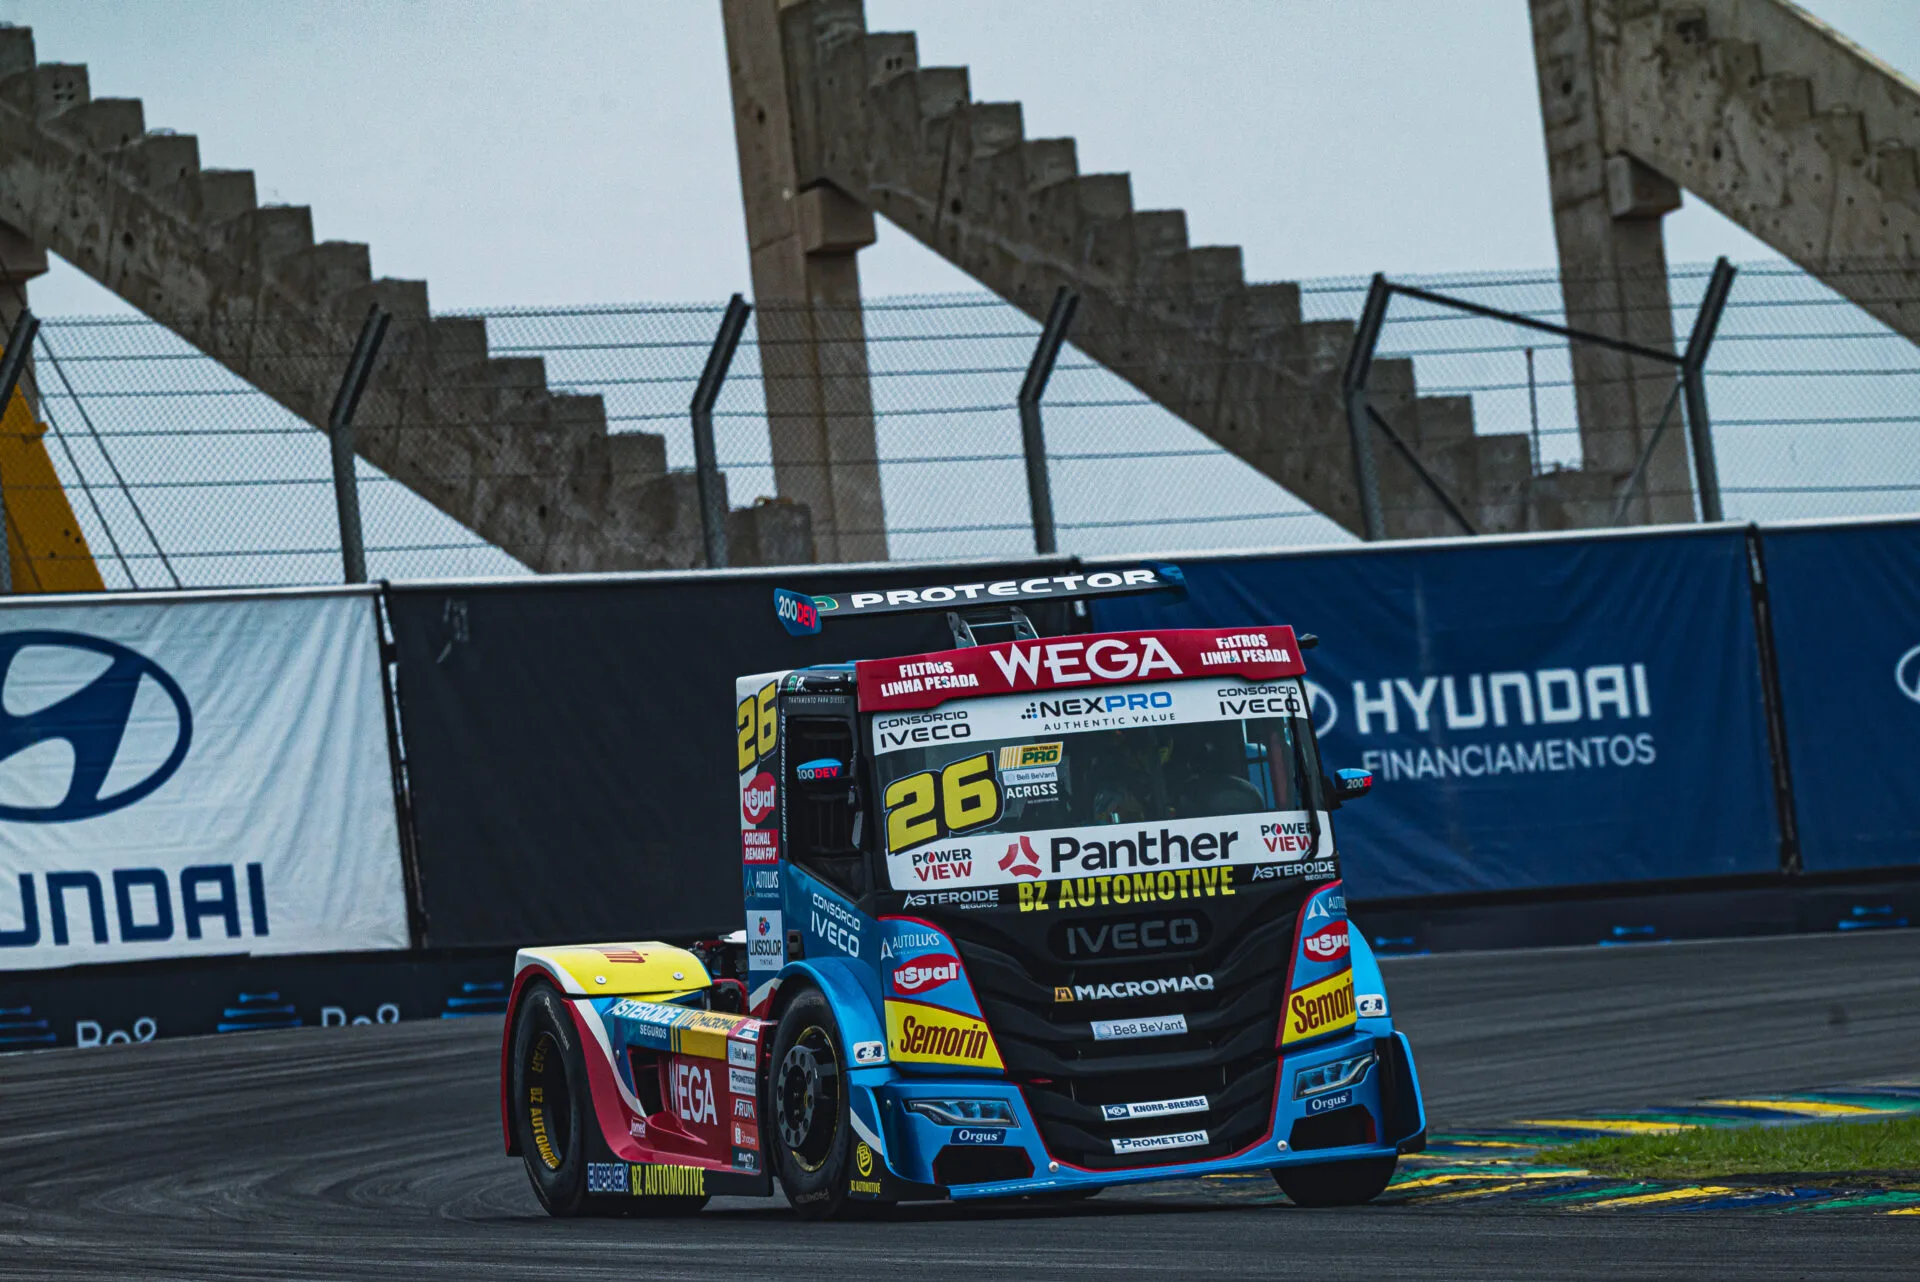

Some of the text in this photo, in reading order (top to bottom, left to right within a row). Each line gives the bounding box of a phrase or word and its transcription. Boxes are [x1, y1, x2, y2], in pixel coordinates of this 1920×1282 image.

[851, 569, 1158, 609] PROTECTOR
[778, 595, 818, 629] 200DEV
[1216, 633, 1269, 650] FILTROS
[989, 637, 1183, 688] WEGA
[1200, 648, 1291, 666] LINHA PESADA
[898, 661, 955, 678] FILTROS
[881, 673, 979, 697] LINHA PESADA
[1217, 683, 1298, 698] CONSÓRCIO
[1040, 690, 1173, 718] NEXPRO
[1220, 697, 1301, 717] IVECO
[1352, 661, 1651, 734] HYUNDAI
[738, 682, 777, 771] 26
[878, 710, 968, 730] CONSÓRCIO
[1043, 712, 1176, 732] AUTHENTIC VALUE
[880, 722, 971, 749] IVECO
[1022, 749, 1058, 764] PRO
[1362, 732, 1656, 783] FINANCIAMENTOS
[1006, 782, 1058, 799] ACROSS
[1346, 776, 1373, 789] 200DE
[744, 785, 775, 817] usual
[886, 754, 998, 853] 26
[911, 848, 972, 867] POWER
[1051, 828, 1238, 873] Panther
[914, 860, 973, 883] VIEW
[1251, 861, 1335, 882] ASTEROIDE
[903, 889, 999, 911] ASTEROIDE
[1018, 866, 1236, 912] BZ AUTOMOTIVE
[812, 893, 861, 932] CONSÓRCIO
[960, 902, 998, 910] SEGUROS
[811, 910, 860, 958] IVECO
[893, 933, 940, 949] AUTOLUKS
[1066, 918, 1199, 954] IVECO
[1306, 934, 1350, 956] usua
[894, 962, 957, 990] usual
[1074, 973, 1215, 1001] MACROMAQ
[639, 1024, 667, 1039] SEGUROS
[900, 1015, 989, 1060] Semorin
[1113, 1020, 1183, 1036] Be8 BeVant
[530, 1087, 543, 1103] BZ
[668, 1064, 718, 1126] WEGA
[1132, 1098, 1206, 1113] KNORR-BREMSE
[1312, 1095, 1346, 1111] Orgus
[958, 1129, 998, 1143] Orgus
[1117, 1133, 1204, 1149] PROMETEON
[631, 1164, 642, 1196] BZ
[645, 1164, 706, 1196] AUTOMOTIVE
